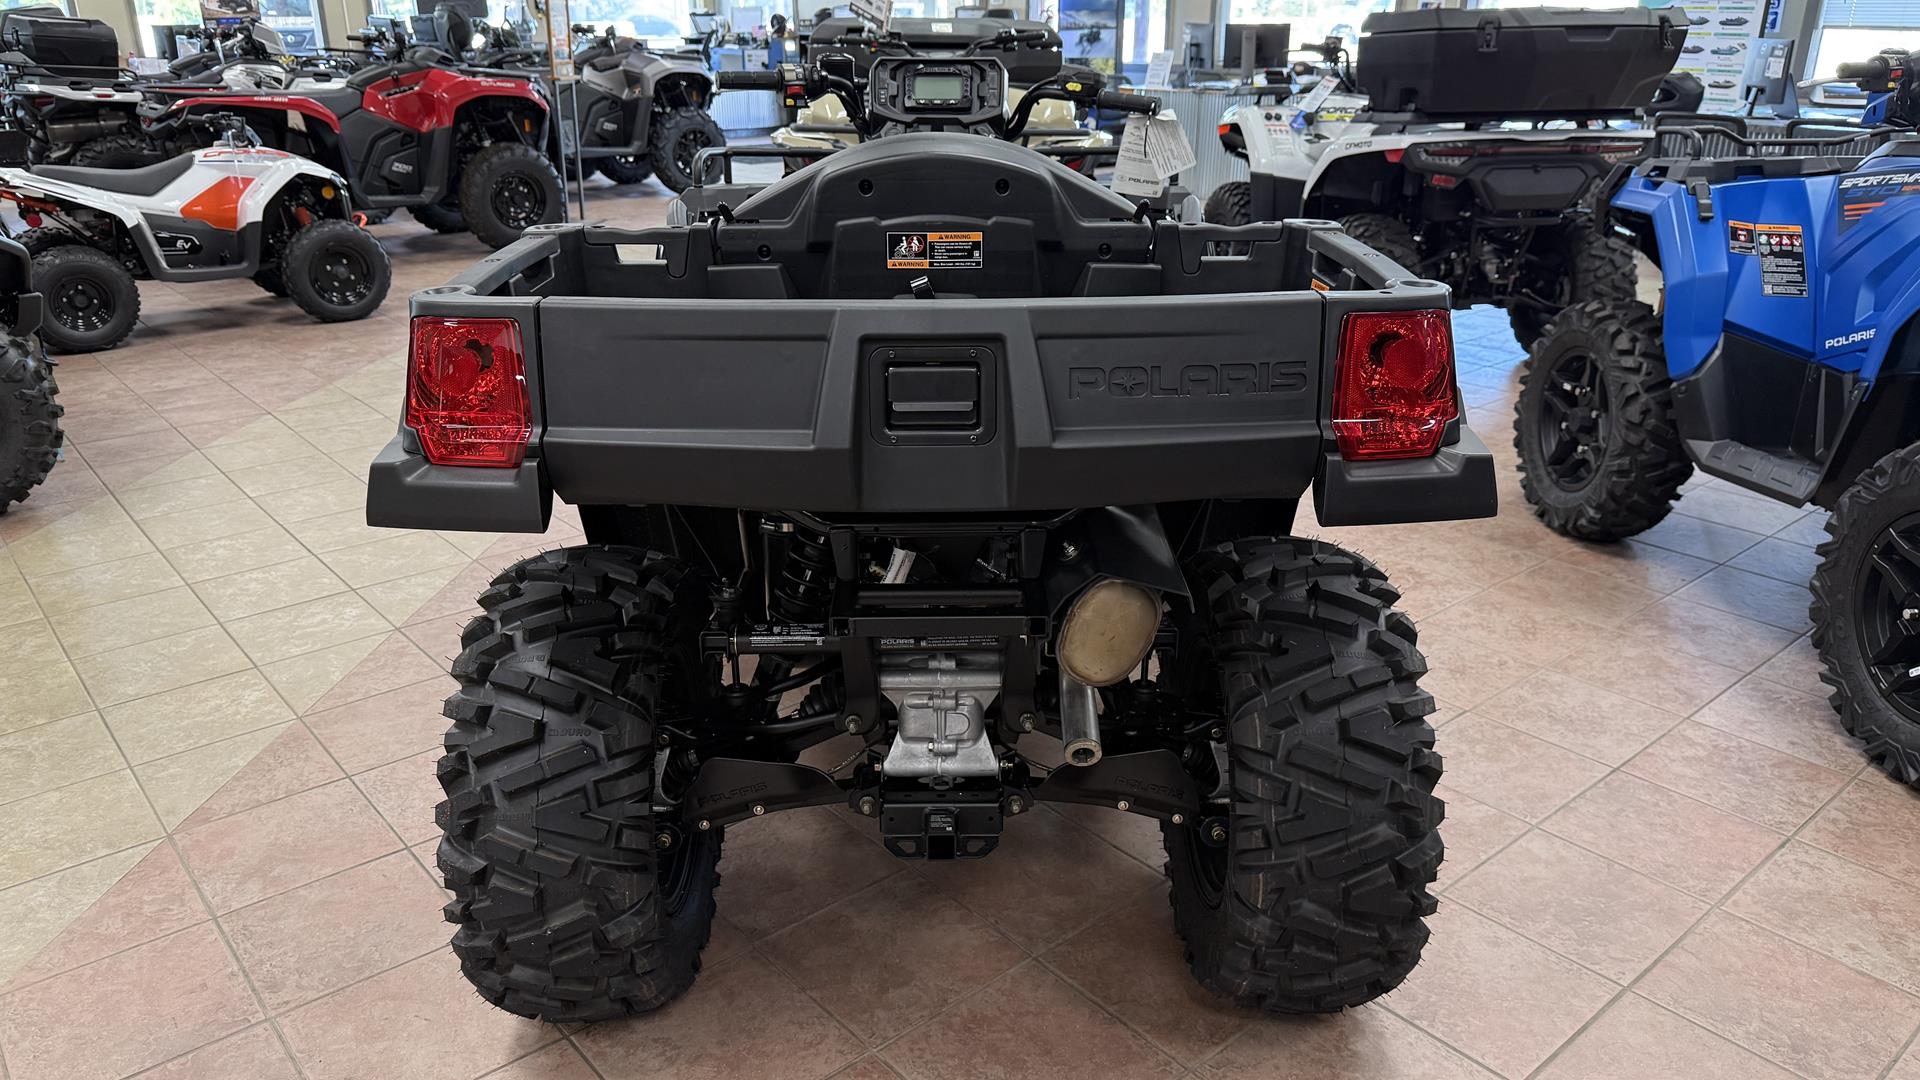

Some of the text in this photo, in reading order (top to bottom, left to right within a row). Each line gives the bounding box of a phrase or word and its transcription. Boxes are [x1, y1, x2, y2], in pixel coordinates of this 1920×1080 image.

[1127, 177, 1160, 186] POLARIS
[1825, 328, 1877, 350] POLARIS
[1069, 361, 1307, 400] POLARIS
